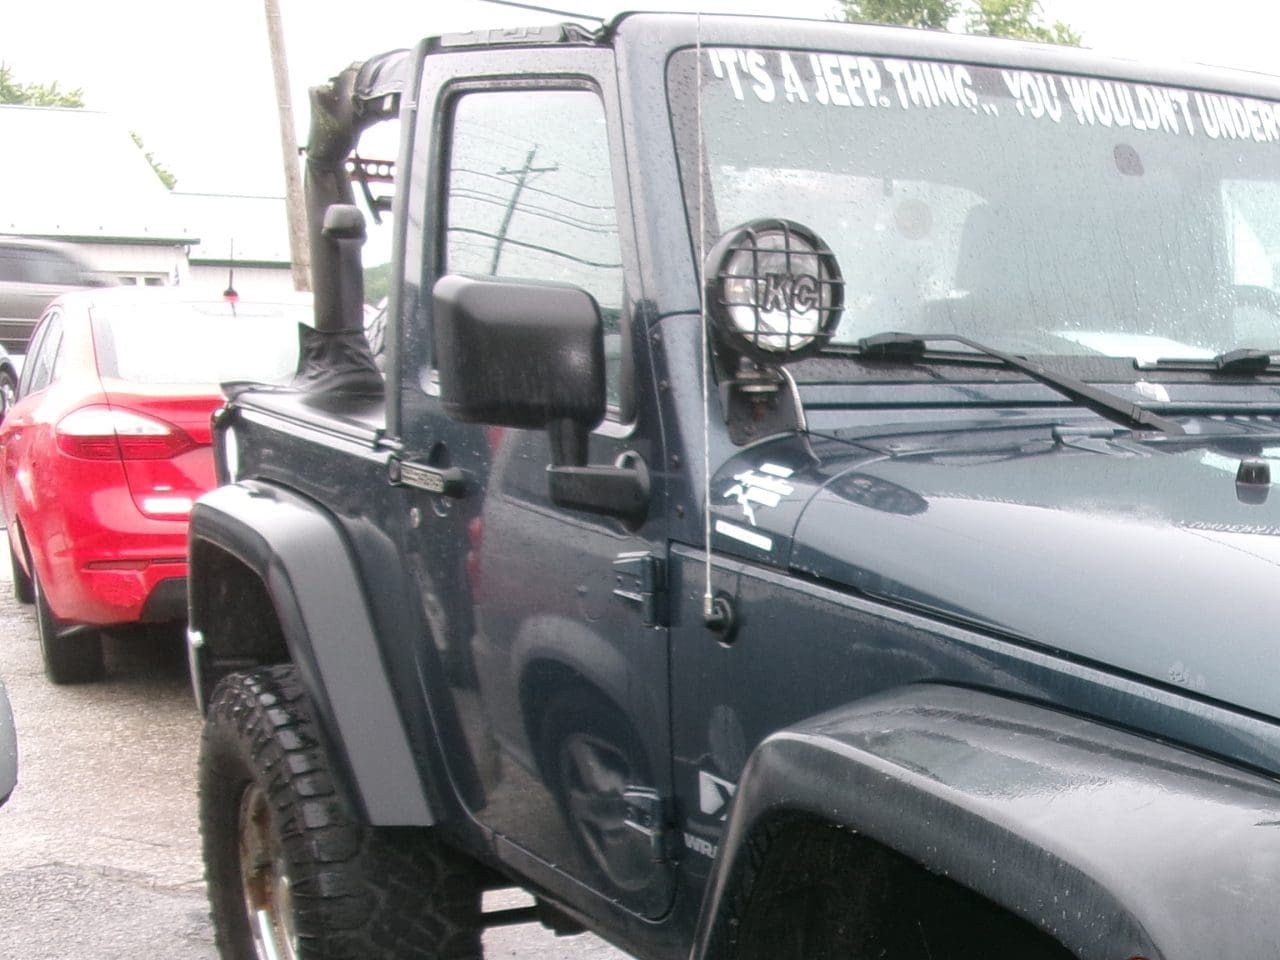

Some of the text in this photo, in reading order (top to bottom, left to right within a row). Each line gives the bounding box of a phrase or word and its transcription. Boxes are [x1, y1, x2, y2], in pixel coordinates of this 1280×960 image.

[780, 50, 809, 103] A
[1001, 69, 1063, 123] YOU
[1060, 77, 1194, 136] WOULDN'T
